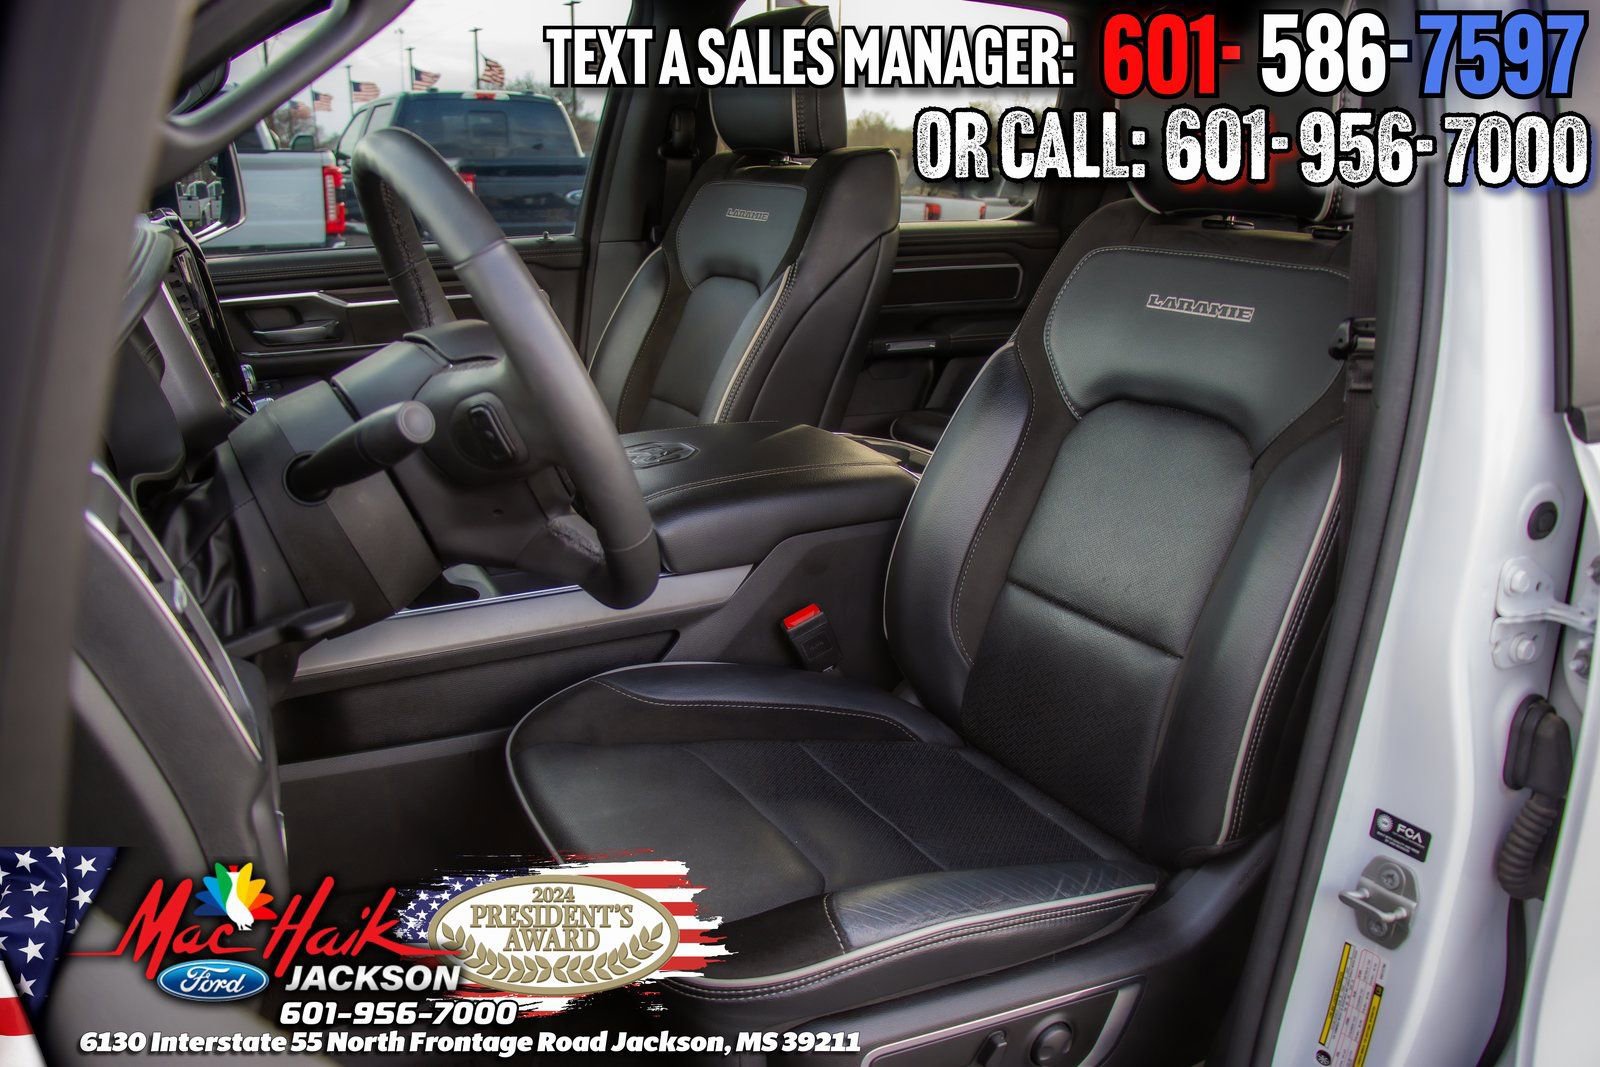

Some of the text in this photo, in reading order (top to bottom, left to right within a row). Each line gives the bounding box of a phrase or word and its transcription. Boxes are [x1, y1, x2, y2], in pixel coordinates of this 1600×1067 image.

[726, 207, 770, 222] LARAMIE
[1146, 294, 1255, 322] LARAMIE
[1395, 822, 1424, 845] FCA
